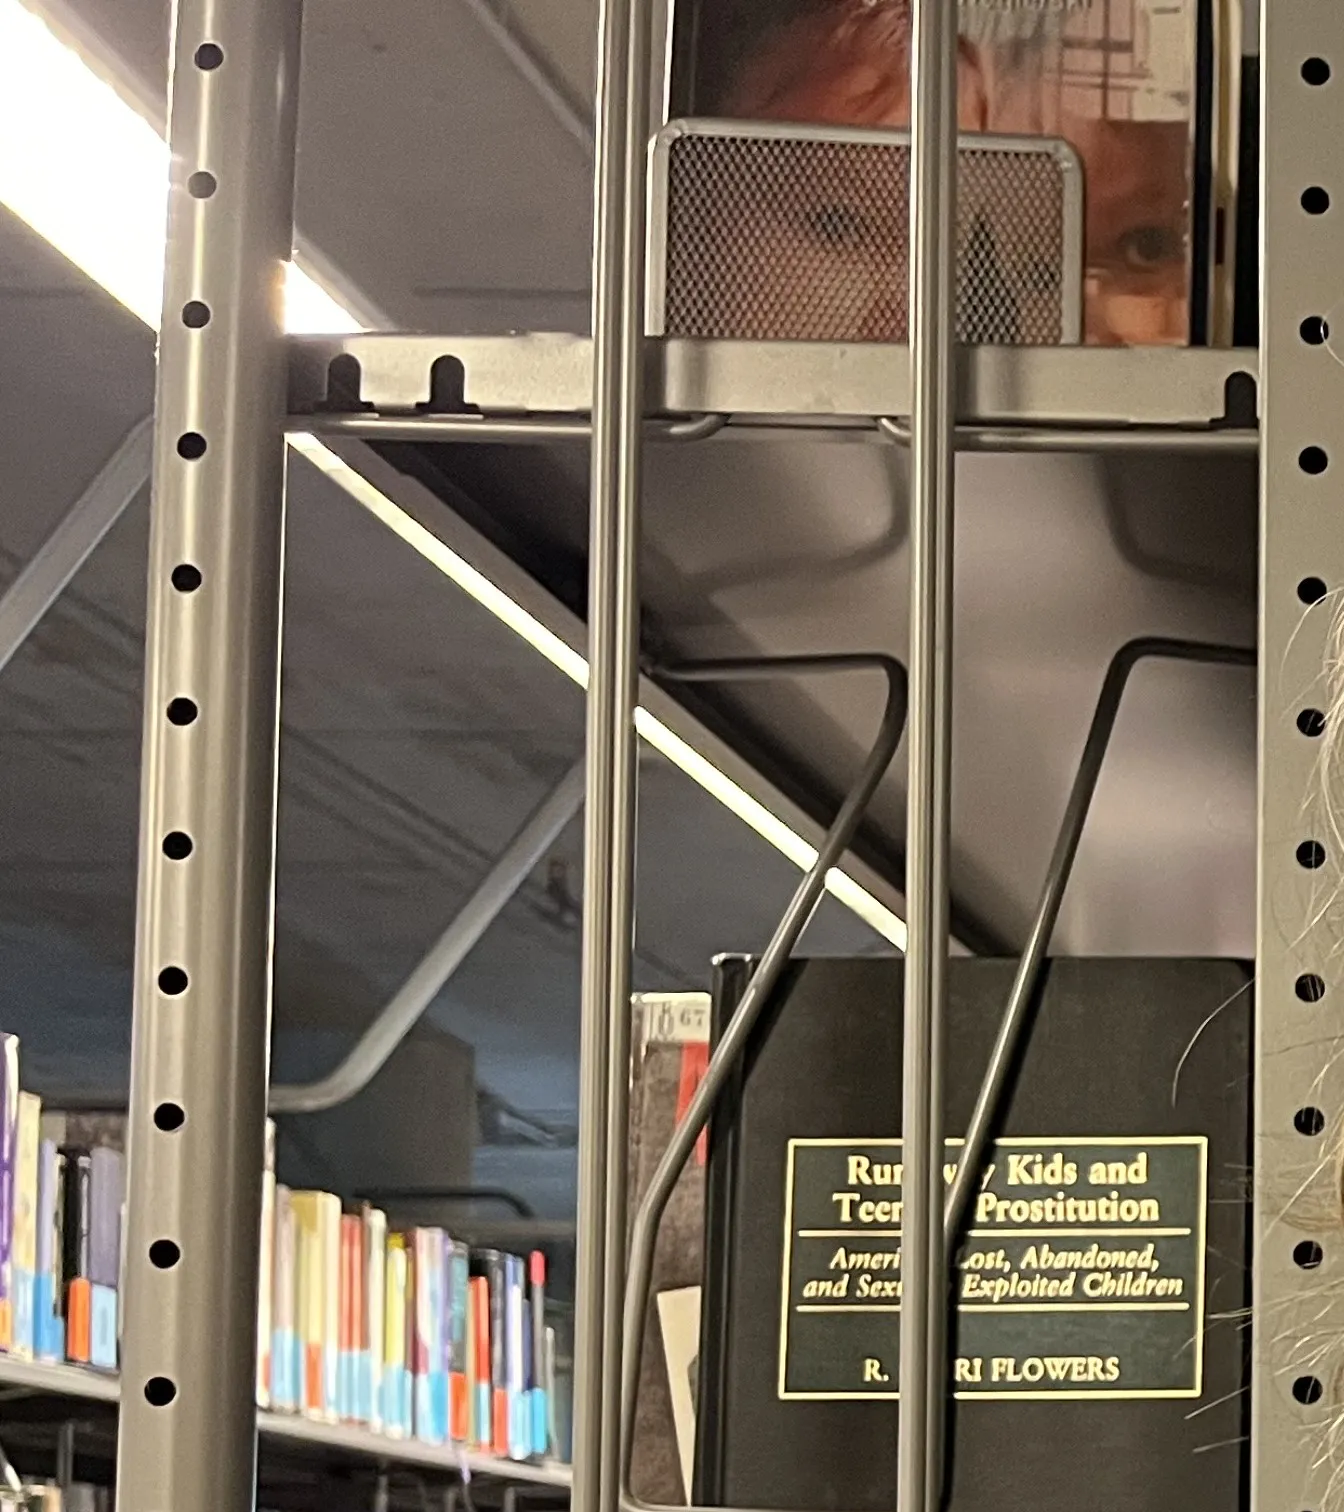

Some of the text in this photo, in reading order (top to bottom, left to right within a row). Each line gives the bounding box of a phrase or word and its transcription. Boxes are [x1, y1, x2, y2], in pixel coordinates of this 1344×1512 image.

[1007, 1153, 1077, 1186] Kids
[1087, 1152, 1148, 1185] and
[975, 1191, 1160, 1224] Prostitution
[1020, 1242, 1160, 1274] Abandoned,
[802, 1273, 848, 1299] and
[961, 1272, 1074, 1303] Exploited
[1083, 1271, 1183, 1299] Children
[863, 1357, 890, 1383] R.
[990, 1356, 1120, 1383] FLOWERS
